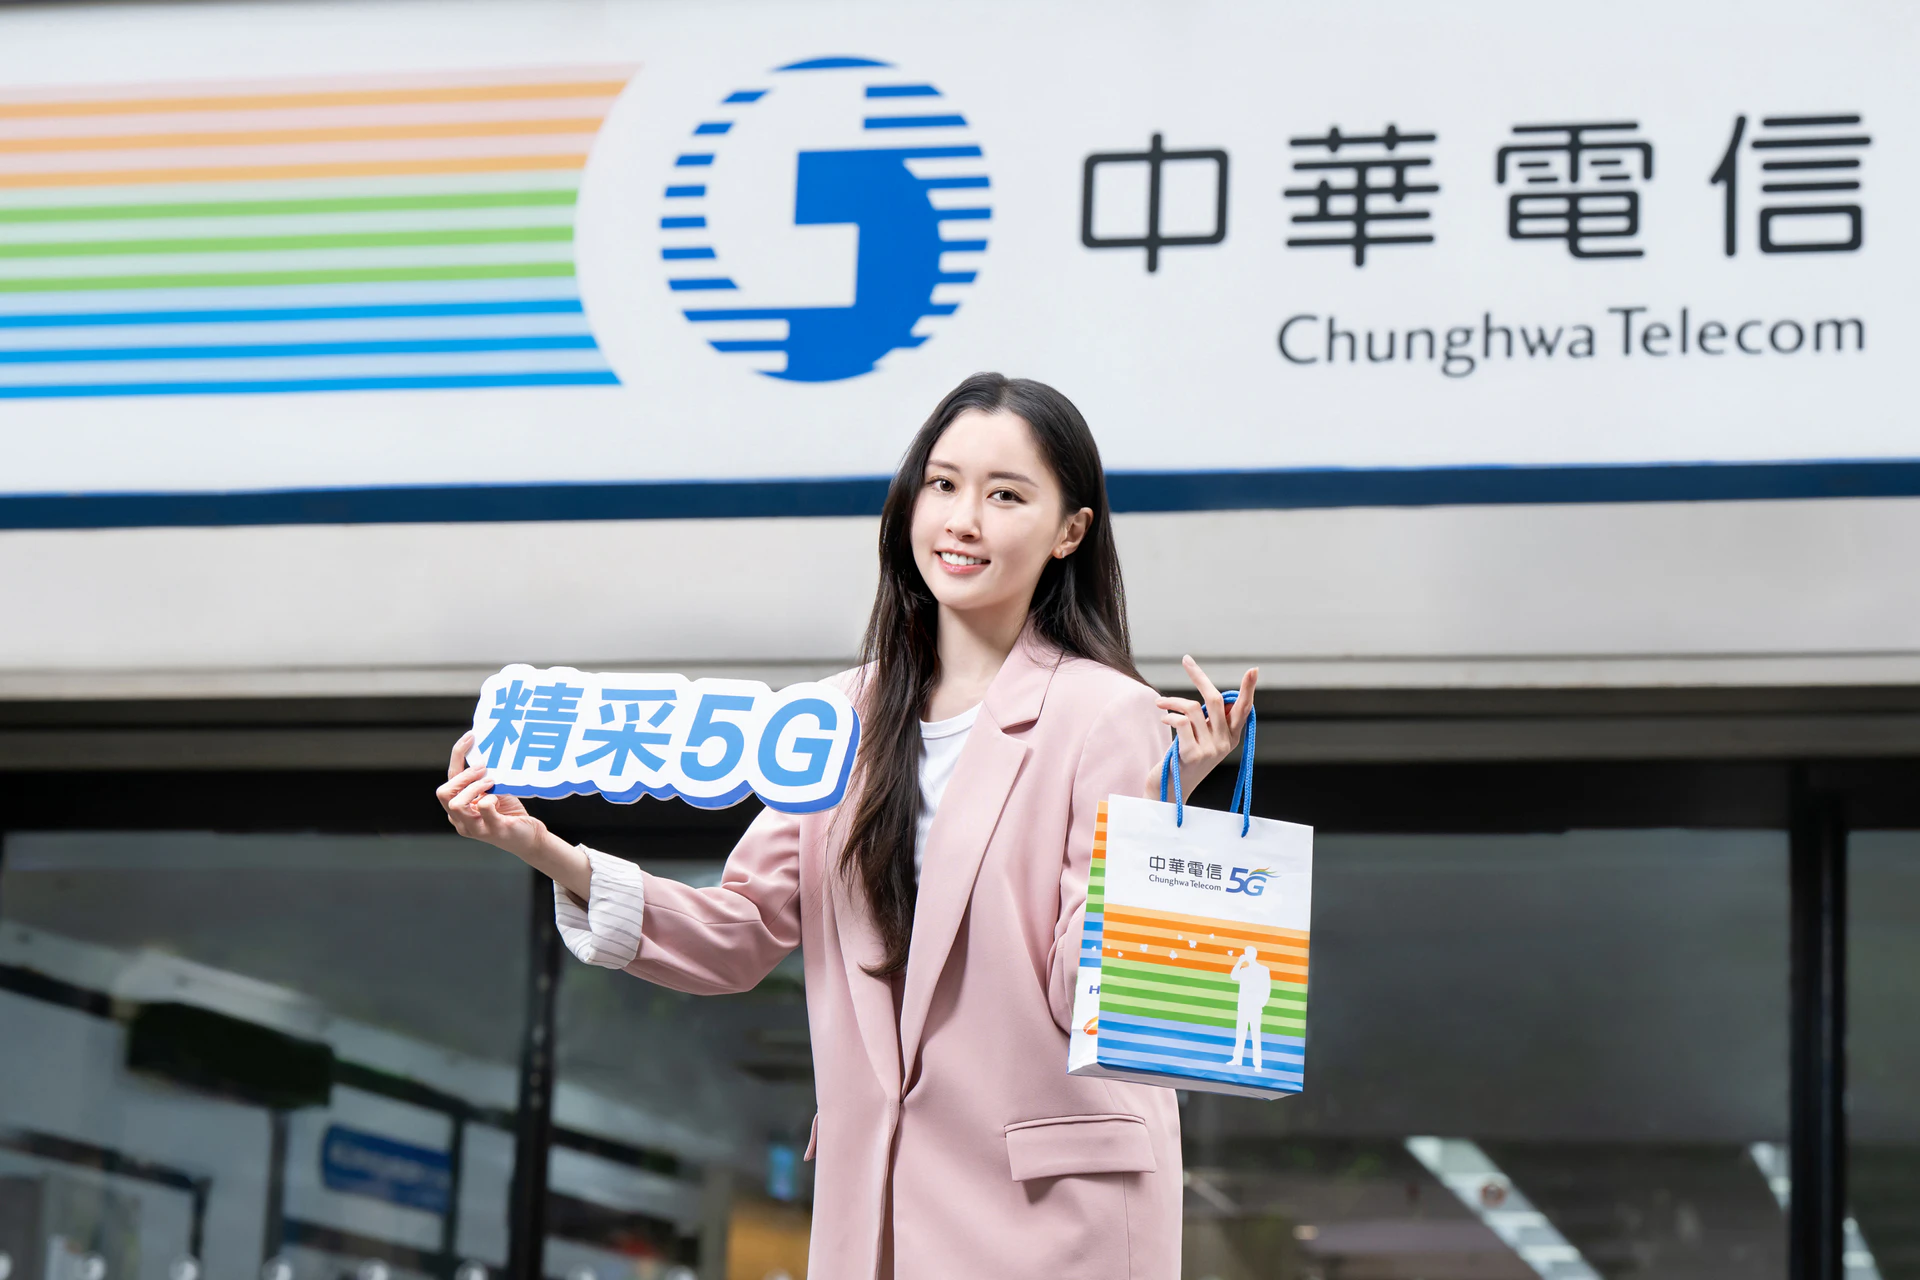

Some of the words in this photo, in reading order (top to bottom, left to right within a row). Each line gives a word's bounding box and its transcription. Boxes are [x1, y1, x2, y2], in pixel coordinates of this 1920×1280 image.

[1081, 113, 1872, 273] 中華電信
[1277, 311, 1597, 376] Chunghwa
[1608, 307, 1866, 357] Telecom
[478, 680, 839, 788] 精采5G
[1148, 873, 1189, 887] Chunghwa
[1190, 879, 1222, 891] Telecom
[1149, 855, 1222, 880] 中華電信
[1225, 866, 1268, 897] 5G
